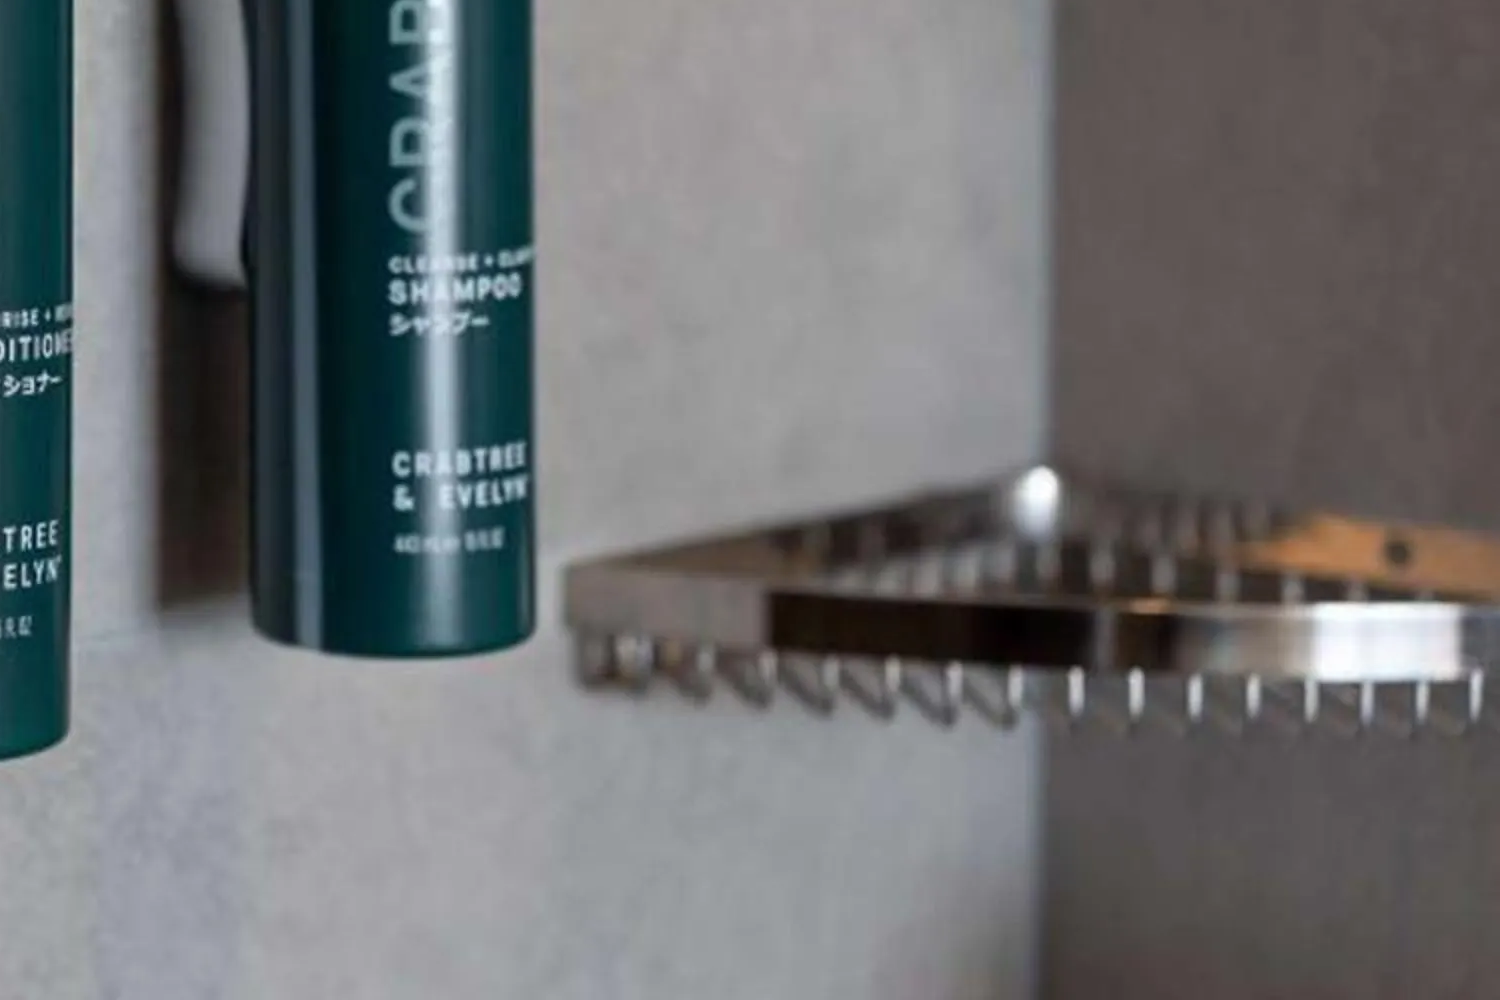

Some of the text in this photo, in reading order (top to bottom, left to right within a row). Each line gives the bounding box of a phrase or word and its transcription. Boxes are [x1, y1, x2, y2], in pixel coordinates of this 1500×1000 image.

[388, 272, 522, 305] SHAMPOO
[392, 440, 526, 478] CRABTREE
[393, 484, 415, 511] &
